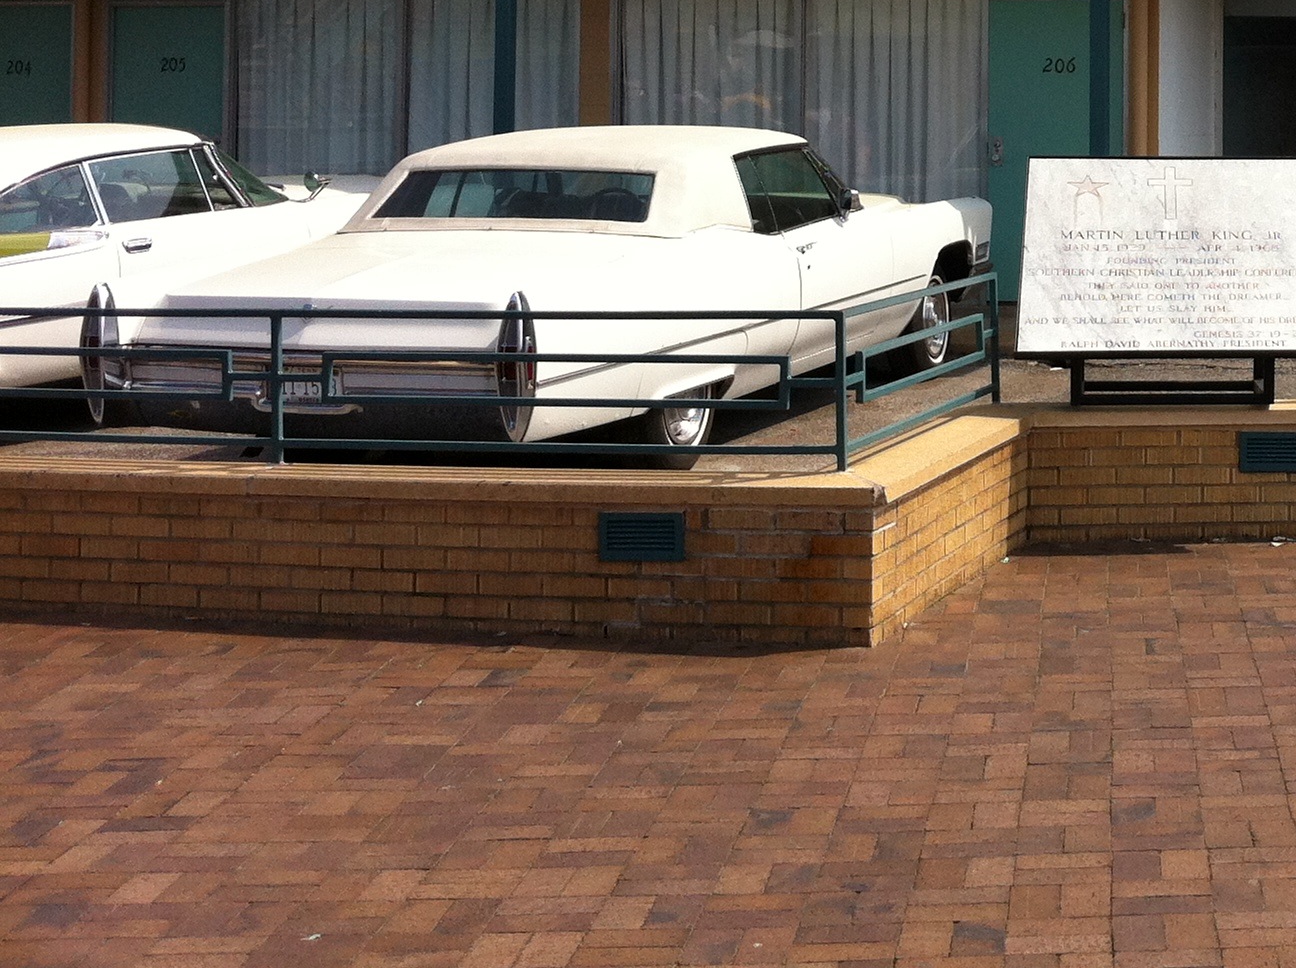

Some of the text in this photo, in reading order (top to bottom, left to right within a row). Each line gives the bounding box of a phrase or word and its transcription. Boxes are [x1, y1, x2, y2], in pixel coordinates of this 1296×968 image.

[5, 59, 32, 76] 204
[160, 56, 186, 73] 205
[1042, 56, 1076, 74] 206
[1060, 229, 1124, 241] MARTIN
[1135, 229, 1200, 241] LUTHER
[1105, 257, 1236, 265] FOUNDING PRESIDENT
[1026, 268, 1095, 277] SOUTHERN
[1099, 268, 1165, 277] CHRISTIAN
[1170, 268, 1239, 277] LEADERSHIP
[1184, 282, 1200, 290] TO
[1111, 293, 1142, 301] HERE
[1147, 293, 1196, 301] COMETH
[1201, 293, 1221, 301] THE
[1120, 305, 1141, 313] LET
[1147, 305, 1162, 313] US
[1168, 305, 1198, 313] SLAY
[1024, 316, 1049, 325] AND
[1053, 316, 1069, 325] WE
[1072, 316, 1107, 325] SHALL
[1133, 316, 1163, 325] WHAT
[1168, 316, 1194, 325] WILL
[1196, 316, 1240, 325] BECOME
[1193, 330, 1244, 339] GENESIS
[1060, 340, 1099, 349] RALPH
[1104, 340, 1141, 349] DAVID
[1222, 340, 1287, 349] PRESIDENT
